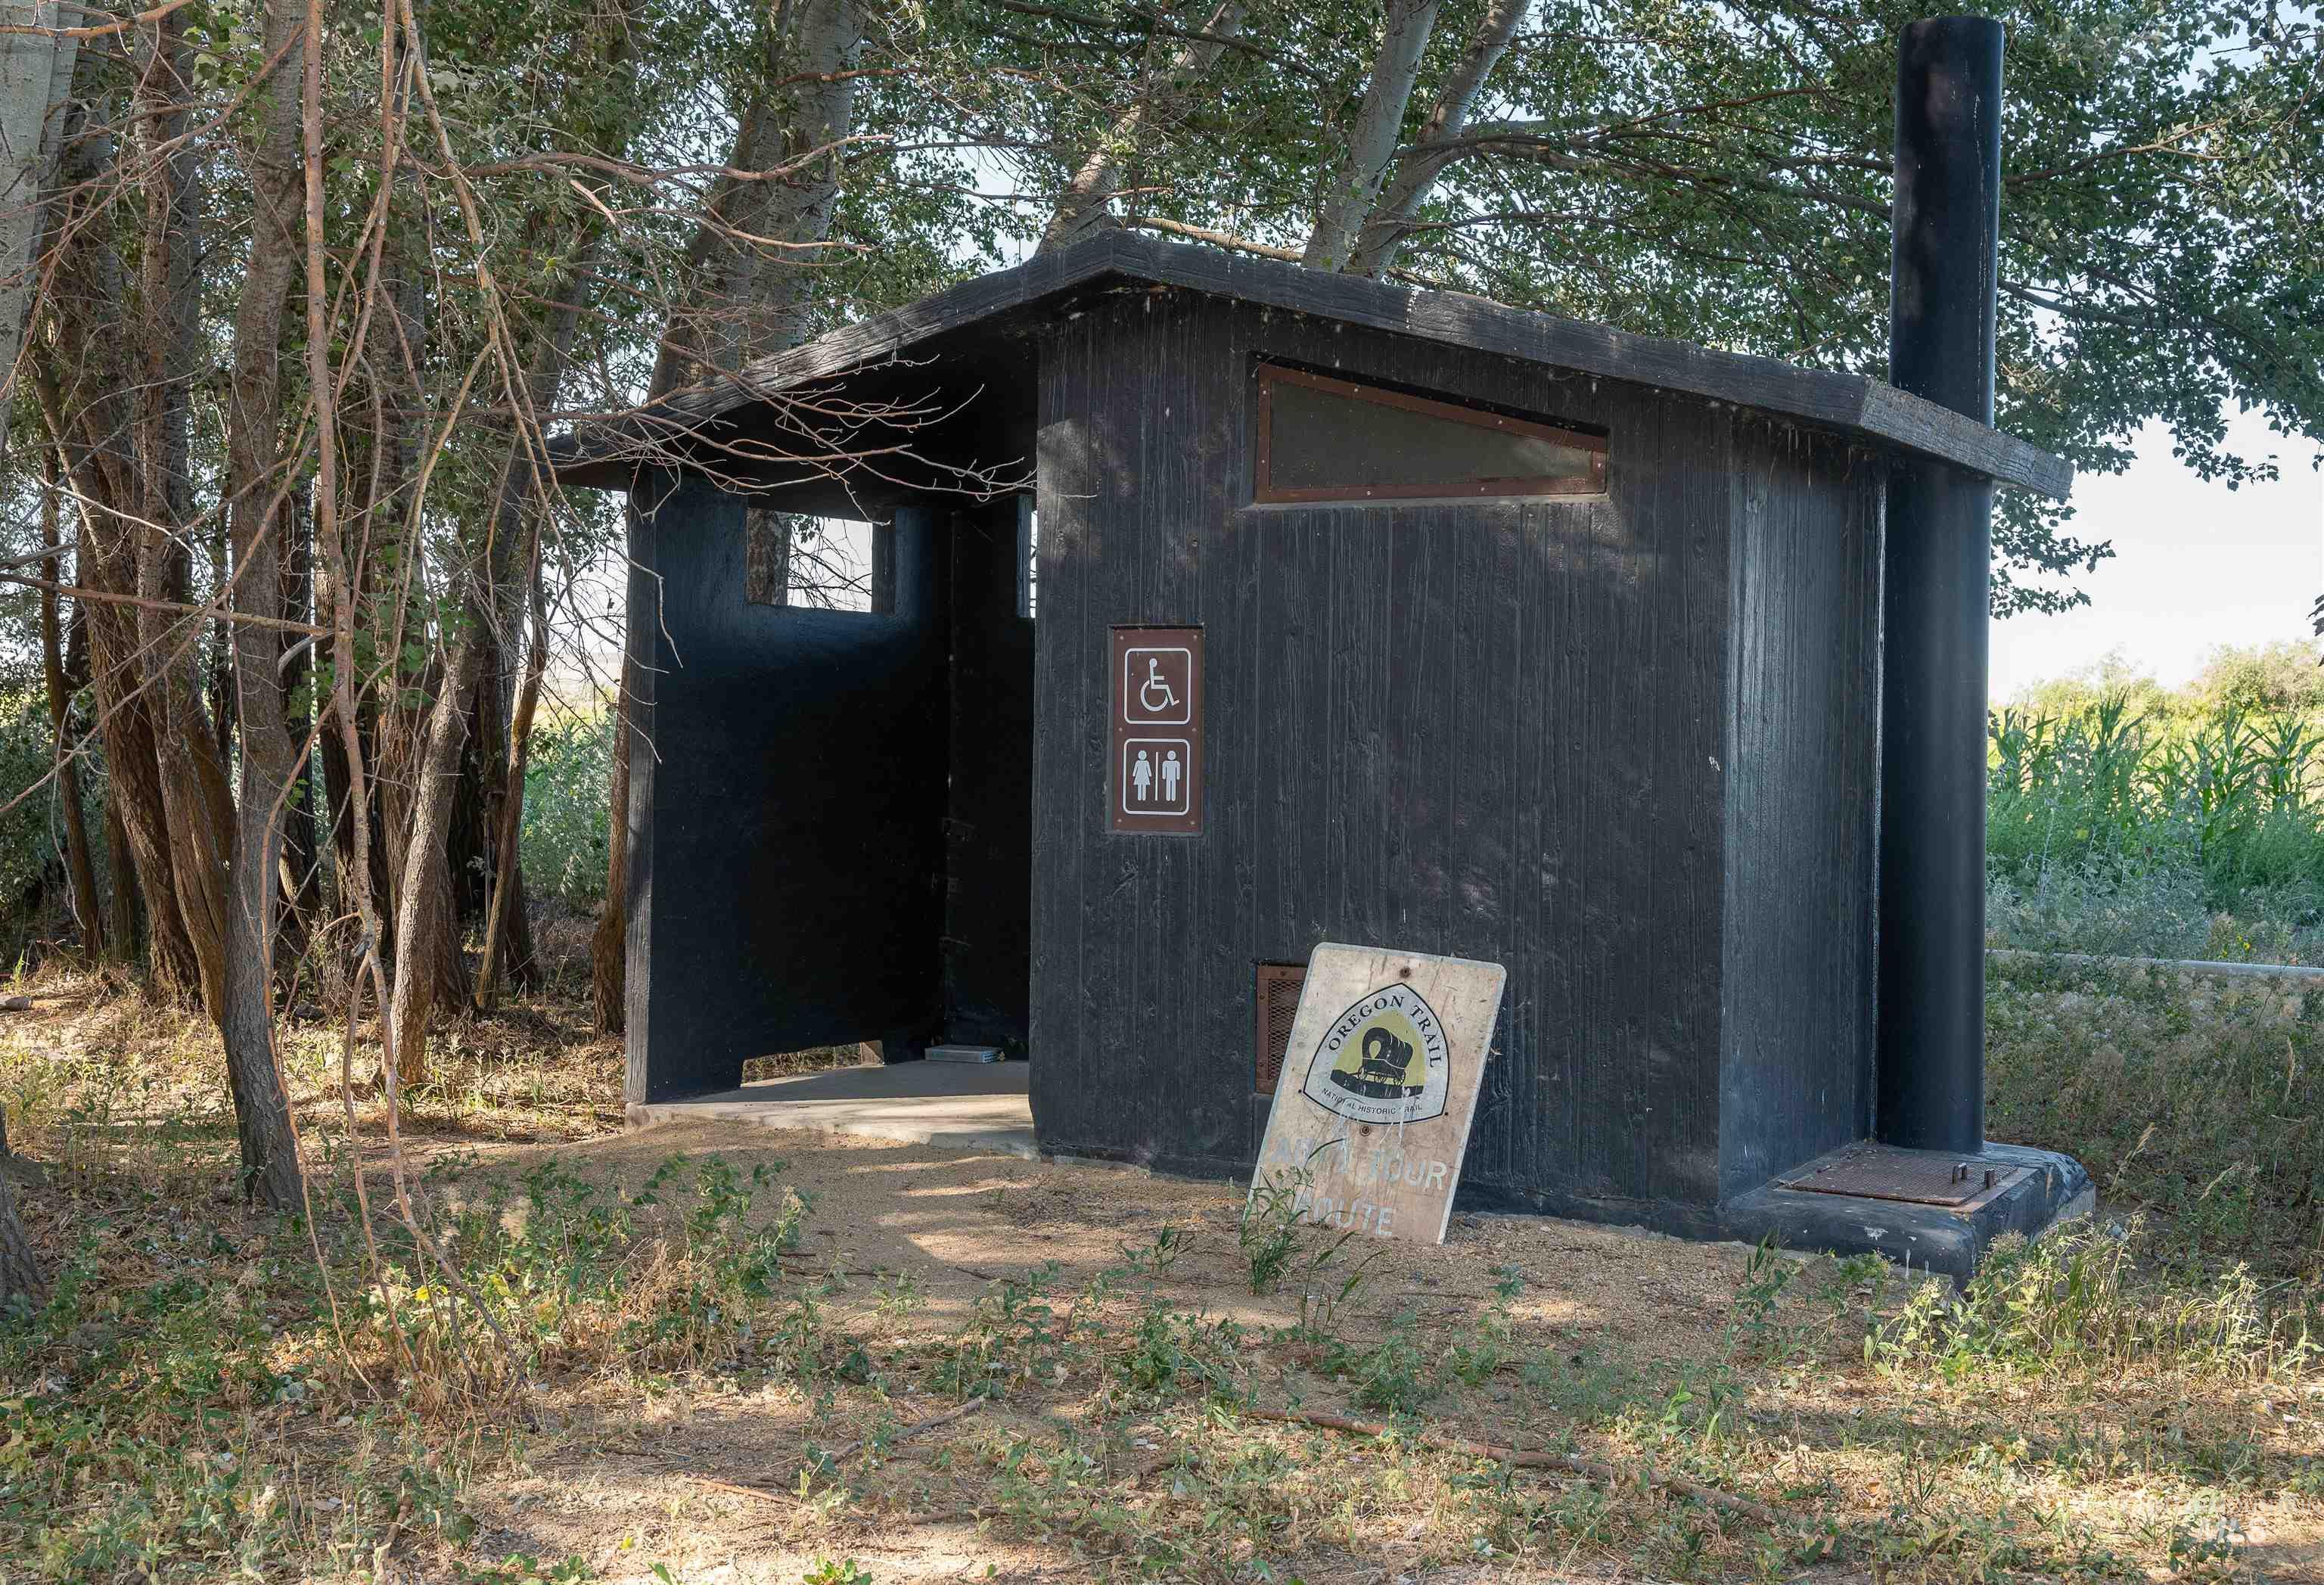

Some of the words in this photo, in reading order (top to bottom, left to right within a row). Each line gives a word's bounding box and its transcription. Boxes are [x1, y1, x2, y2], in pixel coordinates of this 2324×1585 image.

[1328, 995, 1405, 1052] OREGON
[1409, 1005, 1443, 1068] TRAIL
[1357, 1103, 1397, 1115] HISTORIC
[1397, 1102, 1423, 1114] RAIL
